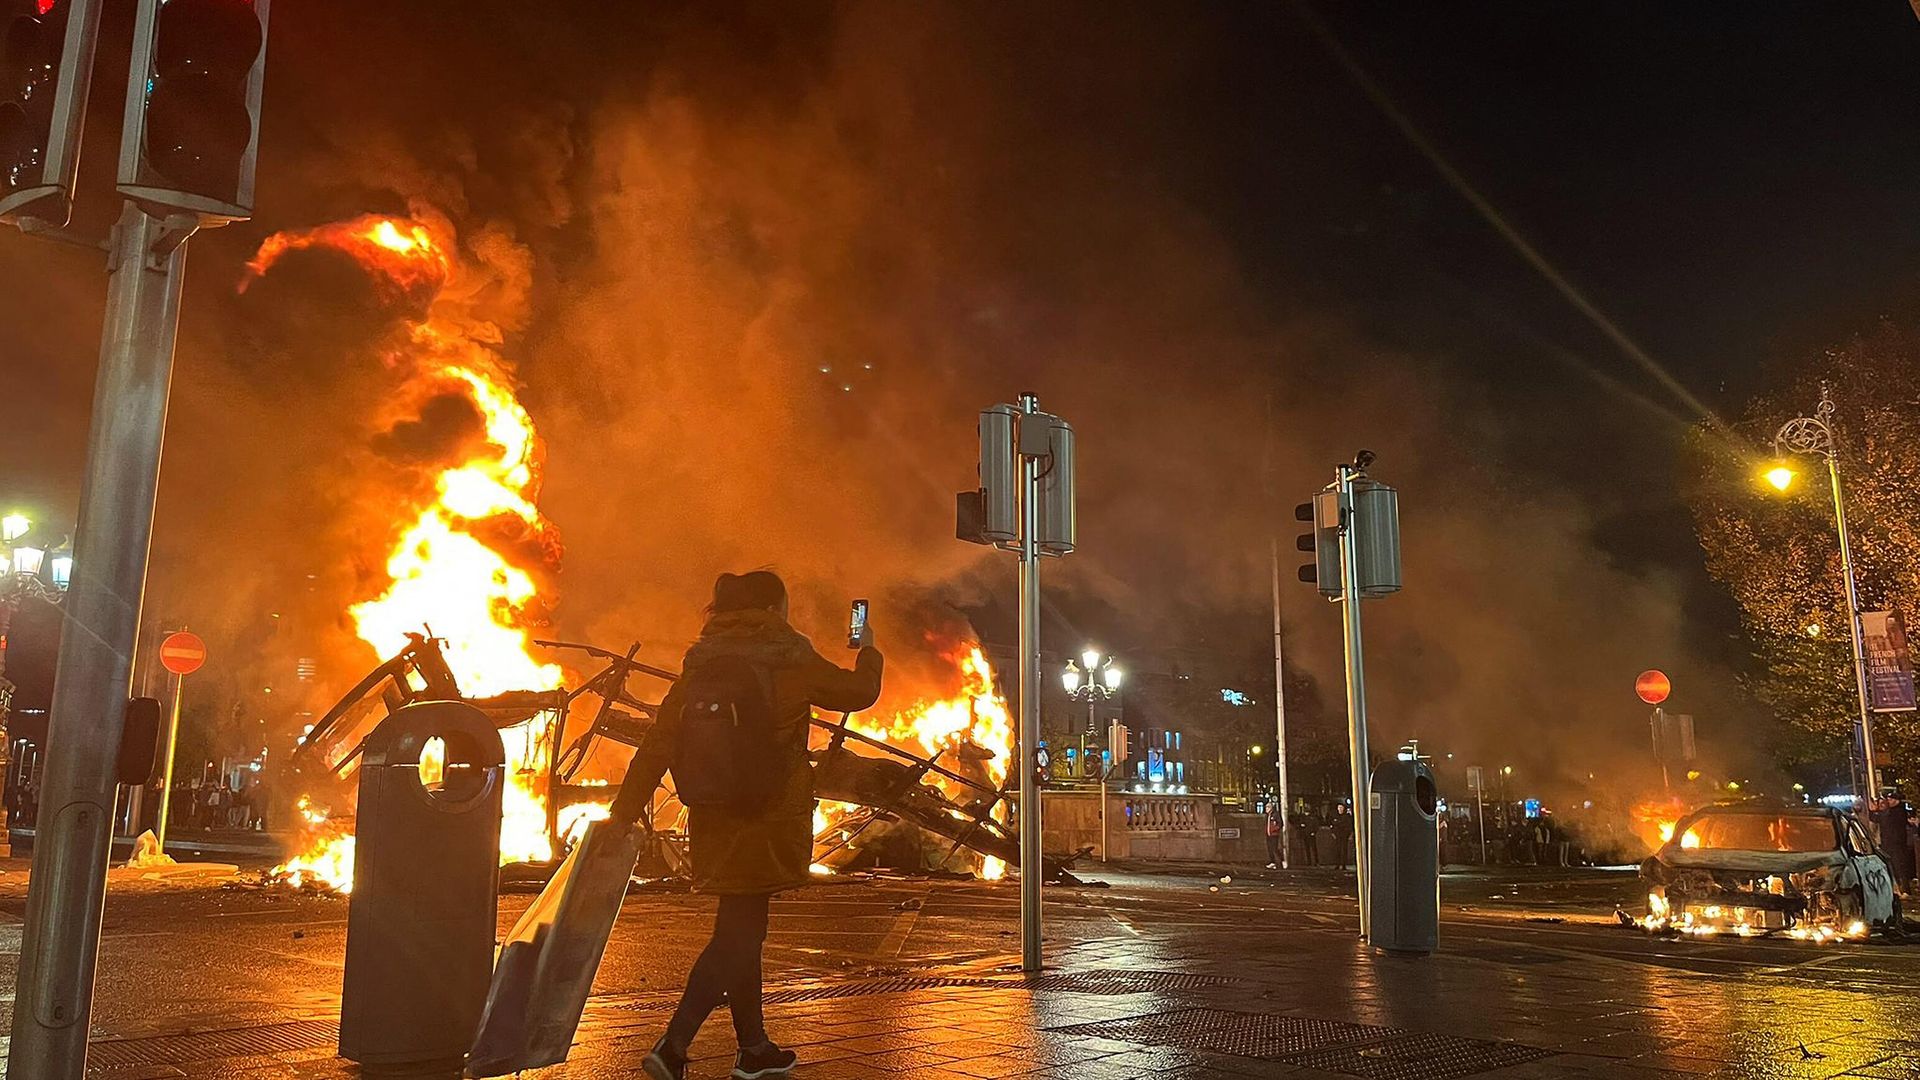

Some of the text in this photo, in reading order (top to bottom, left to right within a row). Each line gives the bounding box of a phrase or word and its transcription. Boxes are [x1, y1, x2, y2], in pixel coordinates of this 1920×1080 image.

[1870, 650, 1896, 658] FRENCH
[1871, 658, 1886, 666] FILM
[1871, 665, 1901, 674] FESTIVAL
